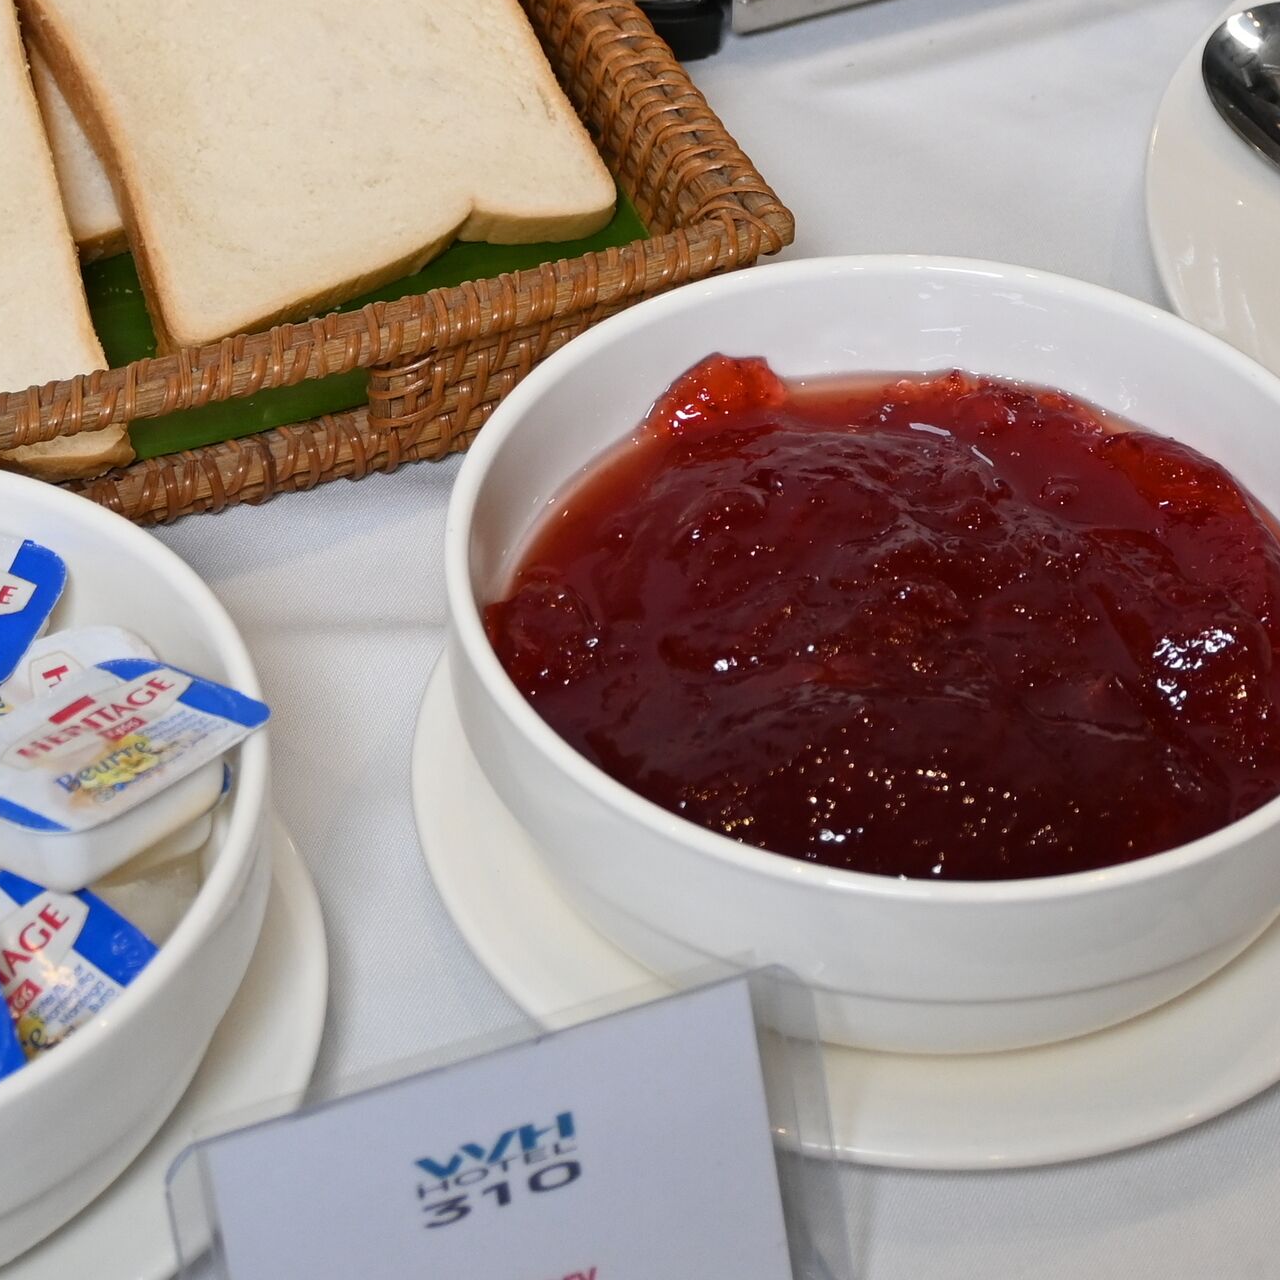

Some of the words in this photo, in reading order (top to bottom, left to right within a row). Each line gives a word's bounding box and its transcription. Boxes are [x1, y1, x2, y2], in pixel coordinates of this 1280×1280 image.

[55, 738, 152, 793] Beurre
[418, 1142, 577, 1200] HOTEL
[422, 1160, 582, 1229] 310
